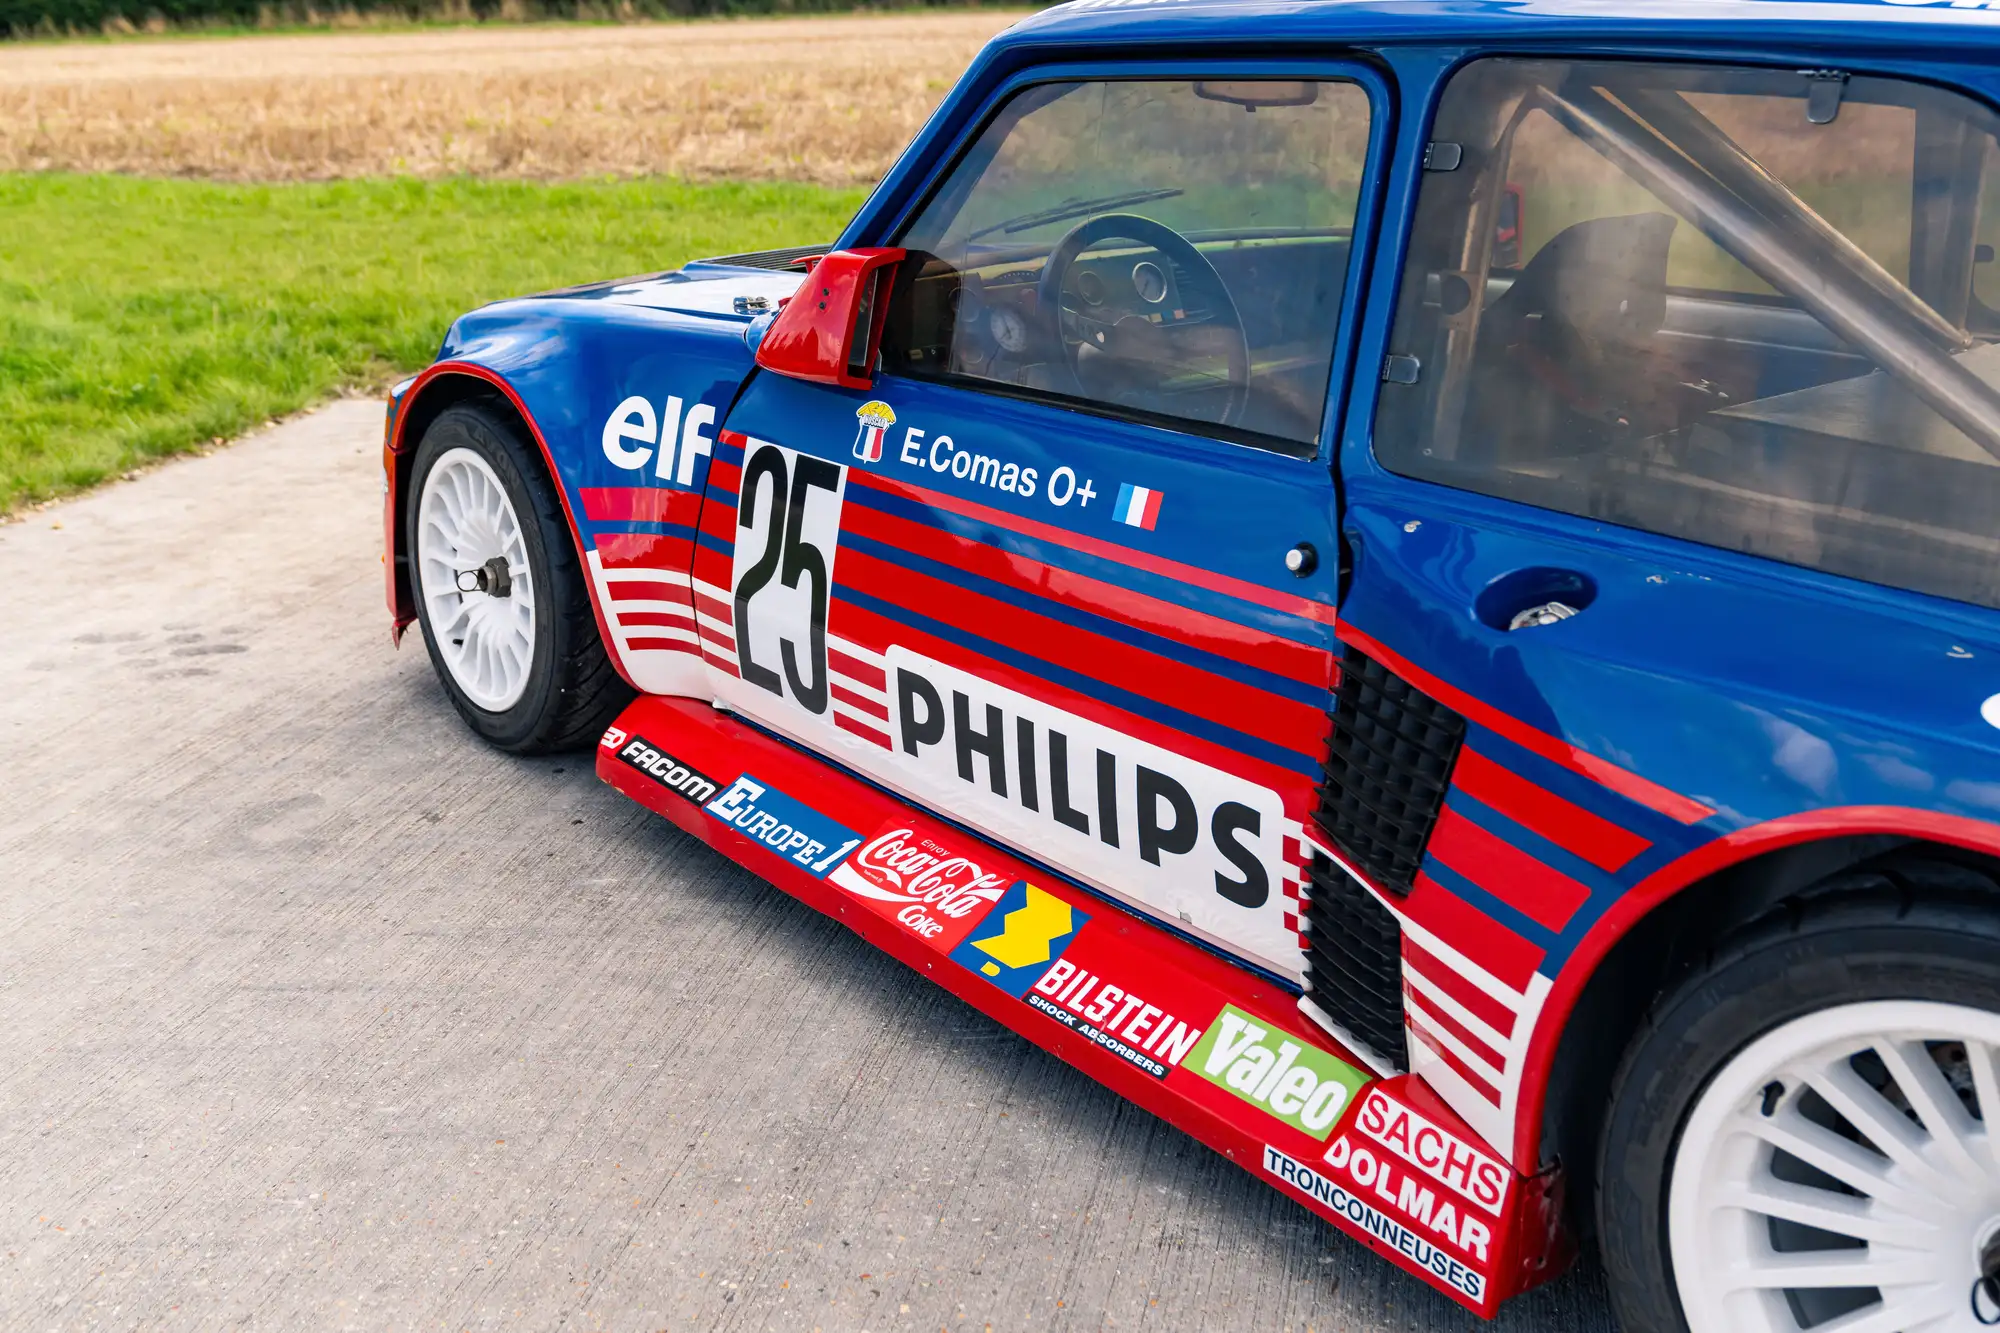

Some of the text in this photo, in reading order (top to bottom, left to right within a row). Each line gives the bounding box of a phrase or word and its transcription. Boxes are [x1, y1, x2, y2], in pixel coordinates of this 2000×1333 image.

[602, 395, 715, 486] elf
[900, 428, 1098, 507] E.Comas O+
[734, 445, 842, 716] 25
[621, 741, 716, 802] FACOM
[896, 666, 1270, 909] PHILIPS
[706, 776, 862, 873] EUROPE 1
[920, 839, 951, 857] Enjoy
[857, 829, 1000, 918] Coca-Cola
[897, 904, 944, 938] Coke
[1029, 995, 1165, 1076] SHOCK ABSORBERS
[1034, 958, 1202, 1066] BILSTEIN
[1203, 1010, 1348, 1130] Valeo
[1323, 1132, 1491, 1262] DOLMAR
[1362, 1093, 1503, 1205] SACHS
[1268, 1148, 1480, 1297] TRONCONNEUSES
